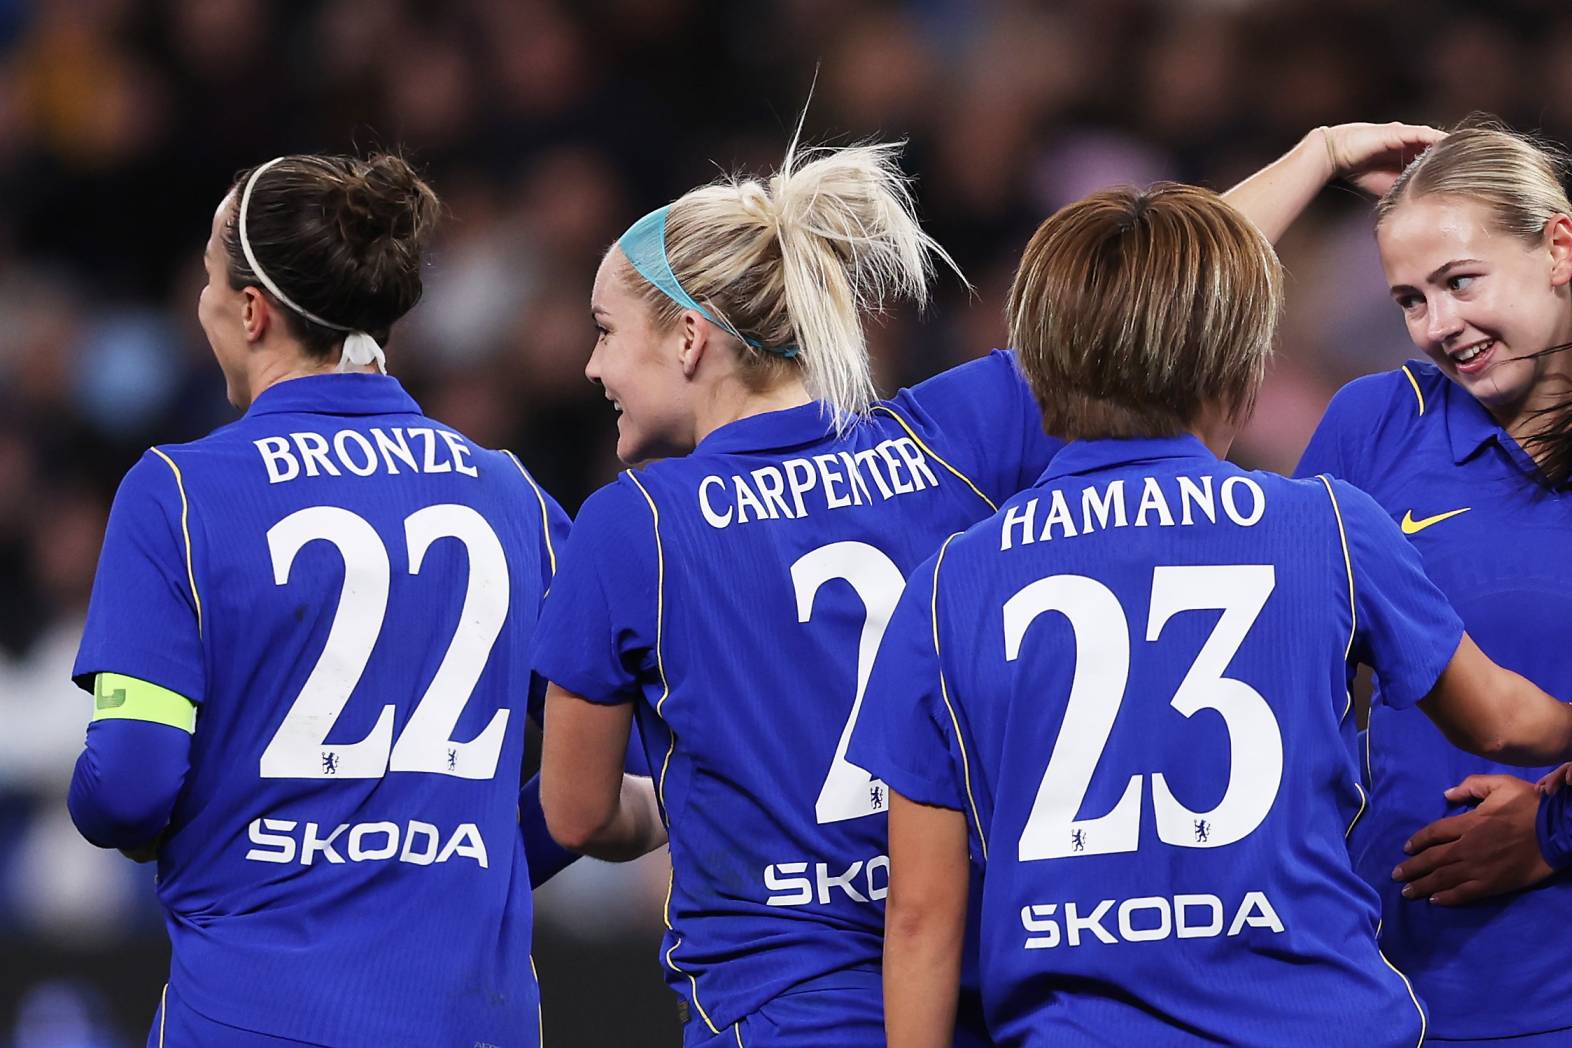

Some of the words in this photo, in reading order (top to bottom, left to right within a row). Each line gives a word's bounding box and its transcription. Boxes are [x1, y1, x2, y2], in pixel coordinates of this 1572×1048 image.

[254, 427, 478, 484] BRONZE
[699, 436, 939, 529] CARPENTER
[1001, 475, 1266, 551] HAMANO
[260, 504, 511, 780] 22
[790, 541, 906, 824] 2
[1003, 565, 1284, 862] 23
[245, 819, 489, 869] SKODA
[1021, 891, 1285, 949] SKODA
